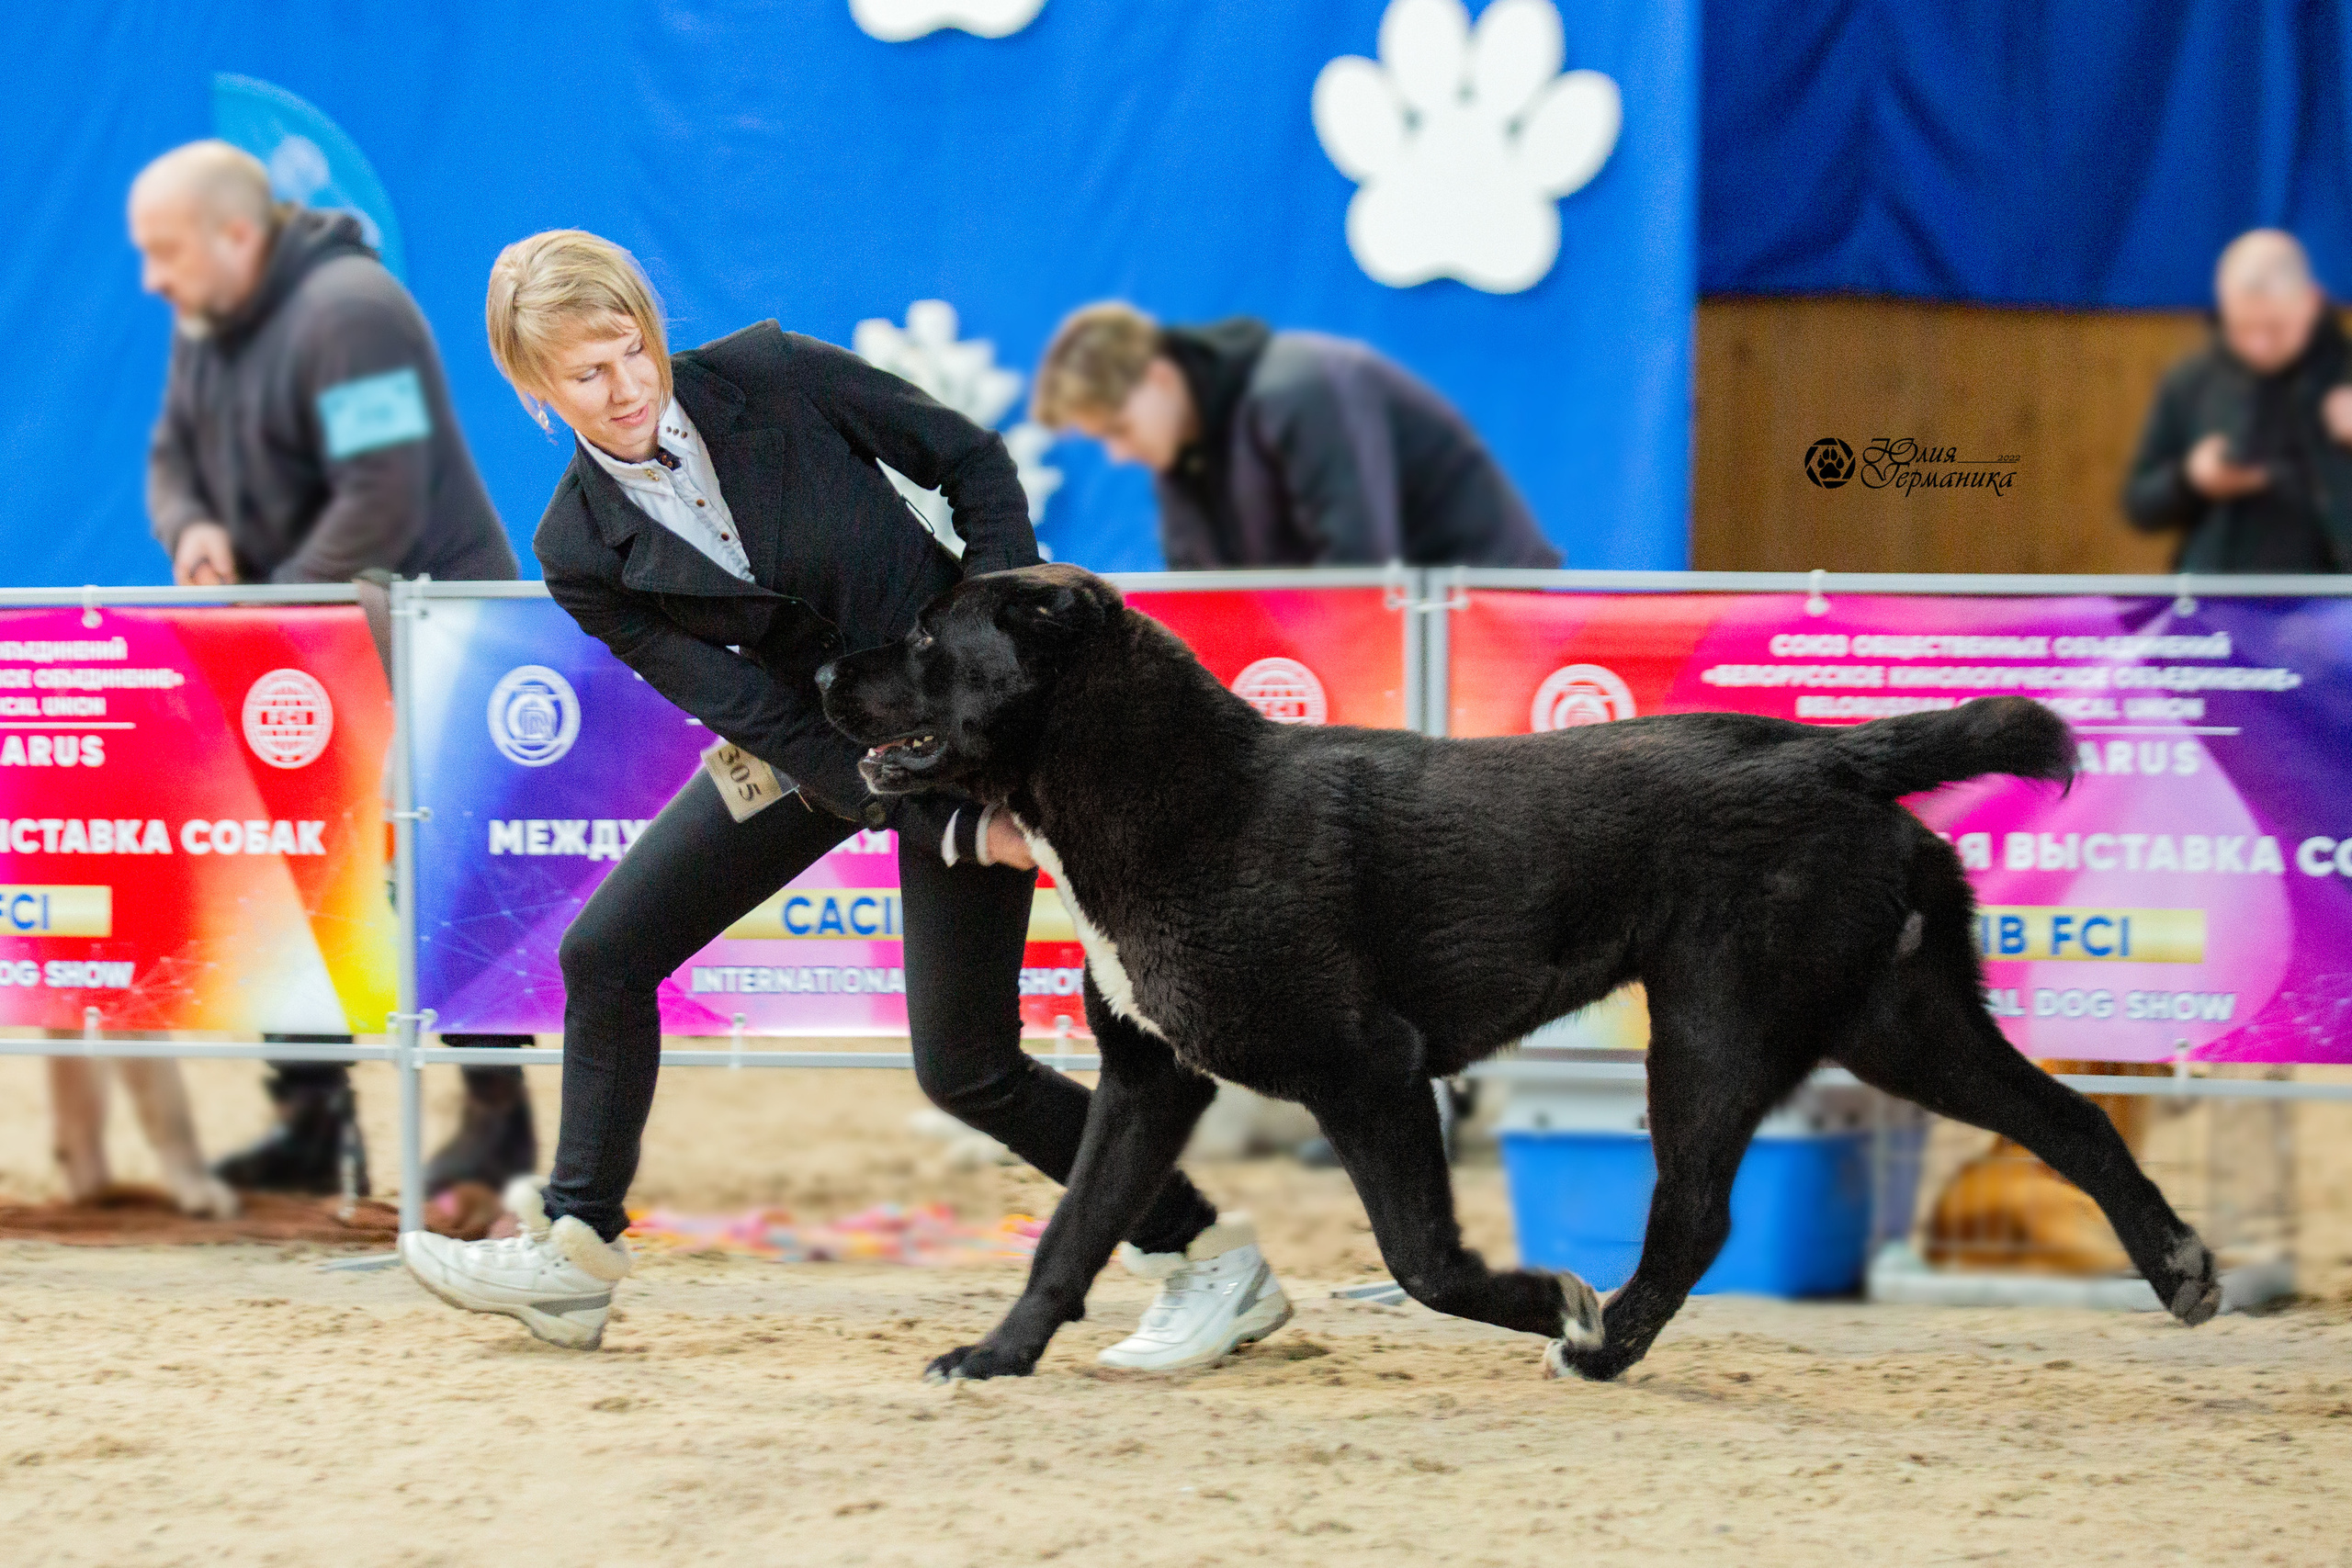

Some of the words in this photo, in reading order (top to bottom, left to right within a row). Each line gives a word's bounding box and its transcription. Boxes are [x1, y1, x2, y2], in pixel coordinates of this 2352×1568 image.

[0, 735, 106, 767] ARUS
[2075, 740, 2201, 775] ARUS
[718, 748, 762, 802] 305
[180, 819, 326, 854] СОБАК
[488, 818, 654, 861] МЕЖДУ
[2004, 832, 2285, 874] ВЫСТАВКА
[2297, 836, 2352, 877] СО
[782, 897, 903, 936] CACI
[2050, 916, 2132, 956] FCI
[44, 960, 135, 988] SHOW
[692, 965, 907, 994] INTERNATIONA
[2033, 988, 2114, 1019] DOG
[2125, 991, 2236, 1022] SHOW
